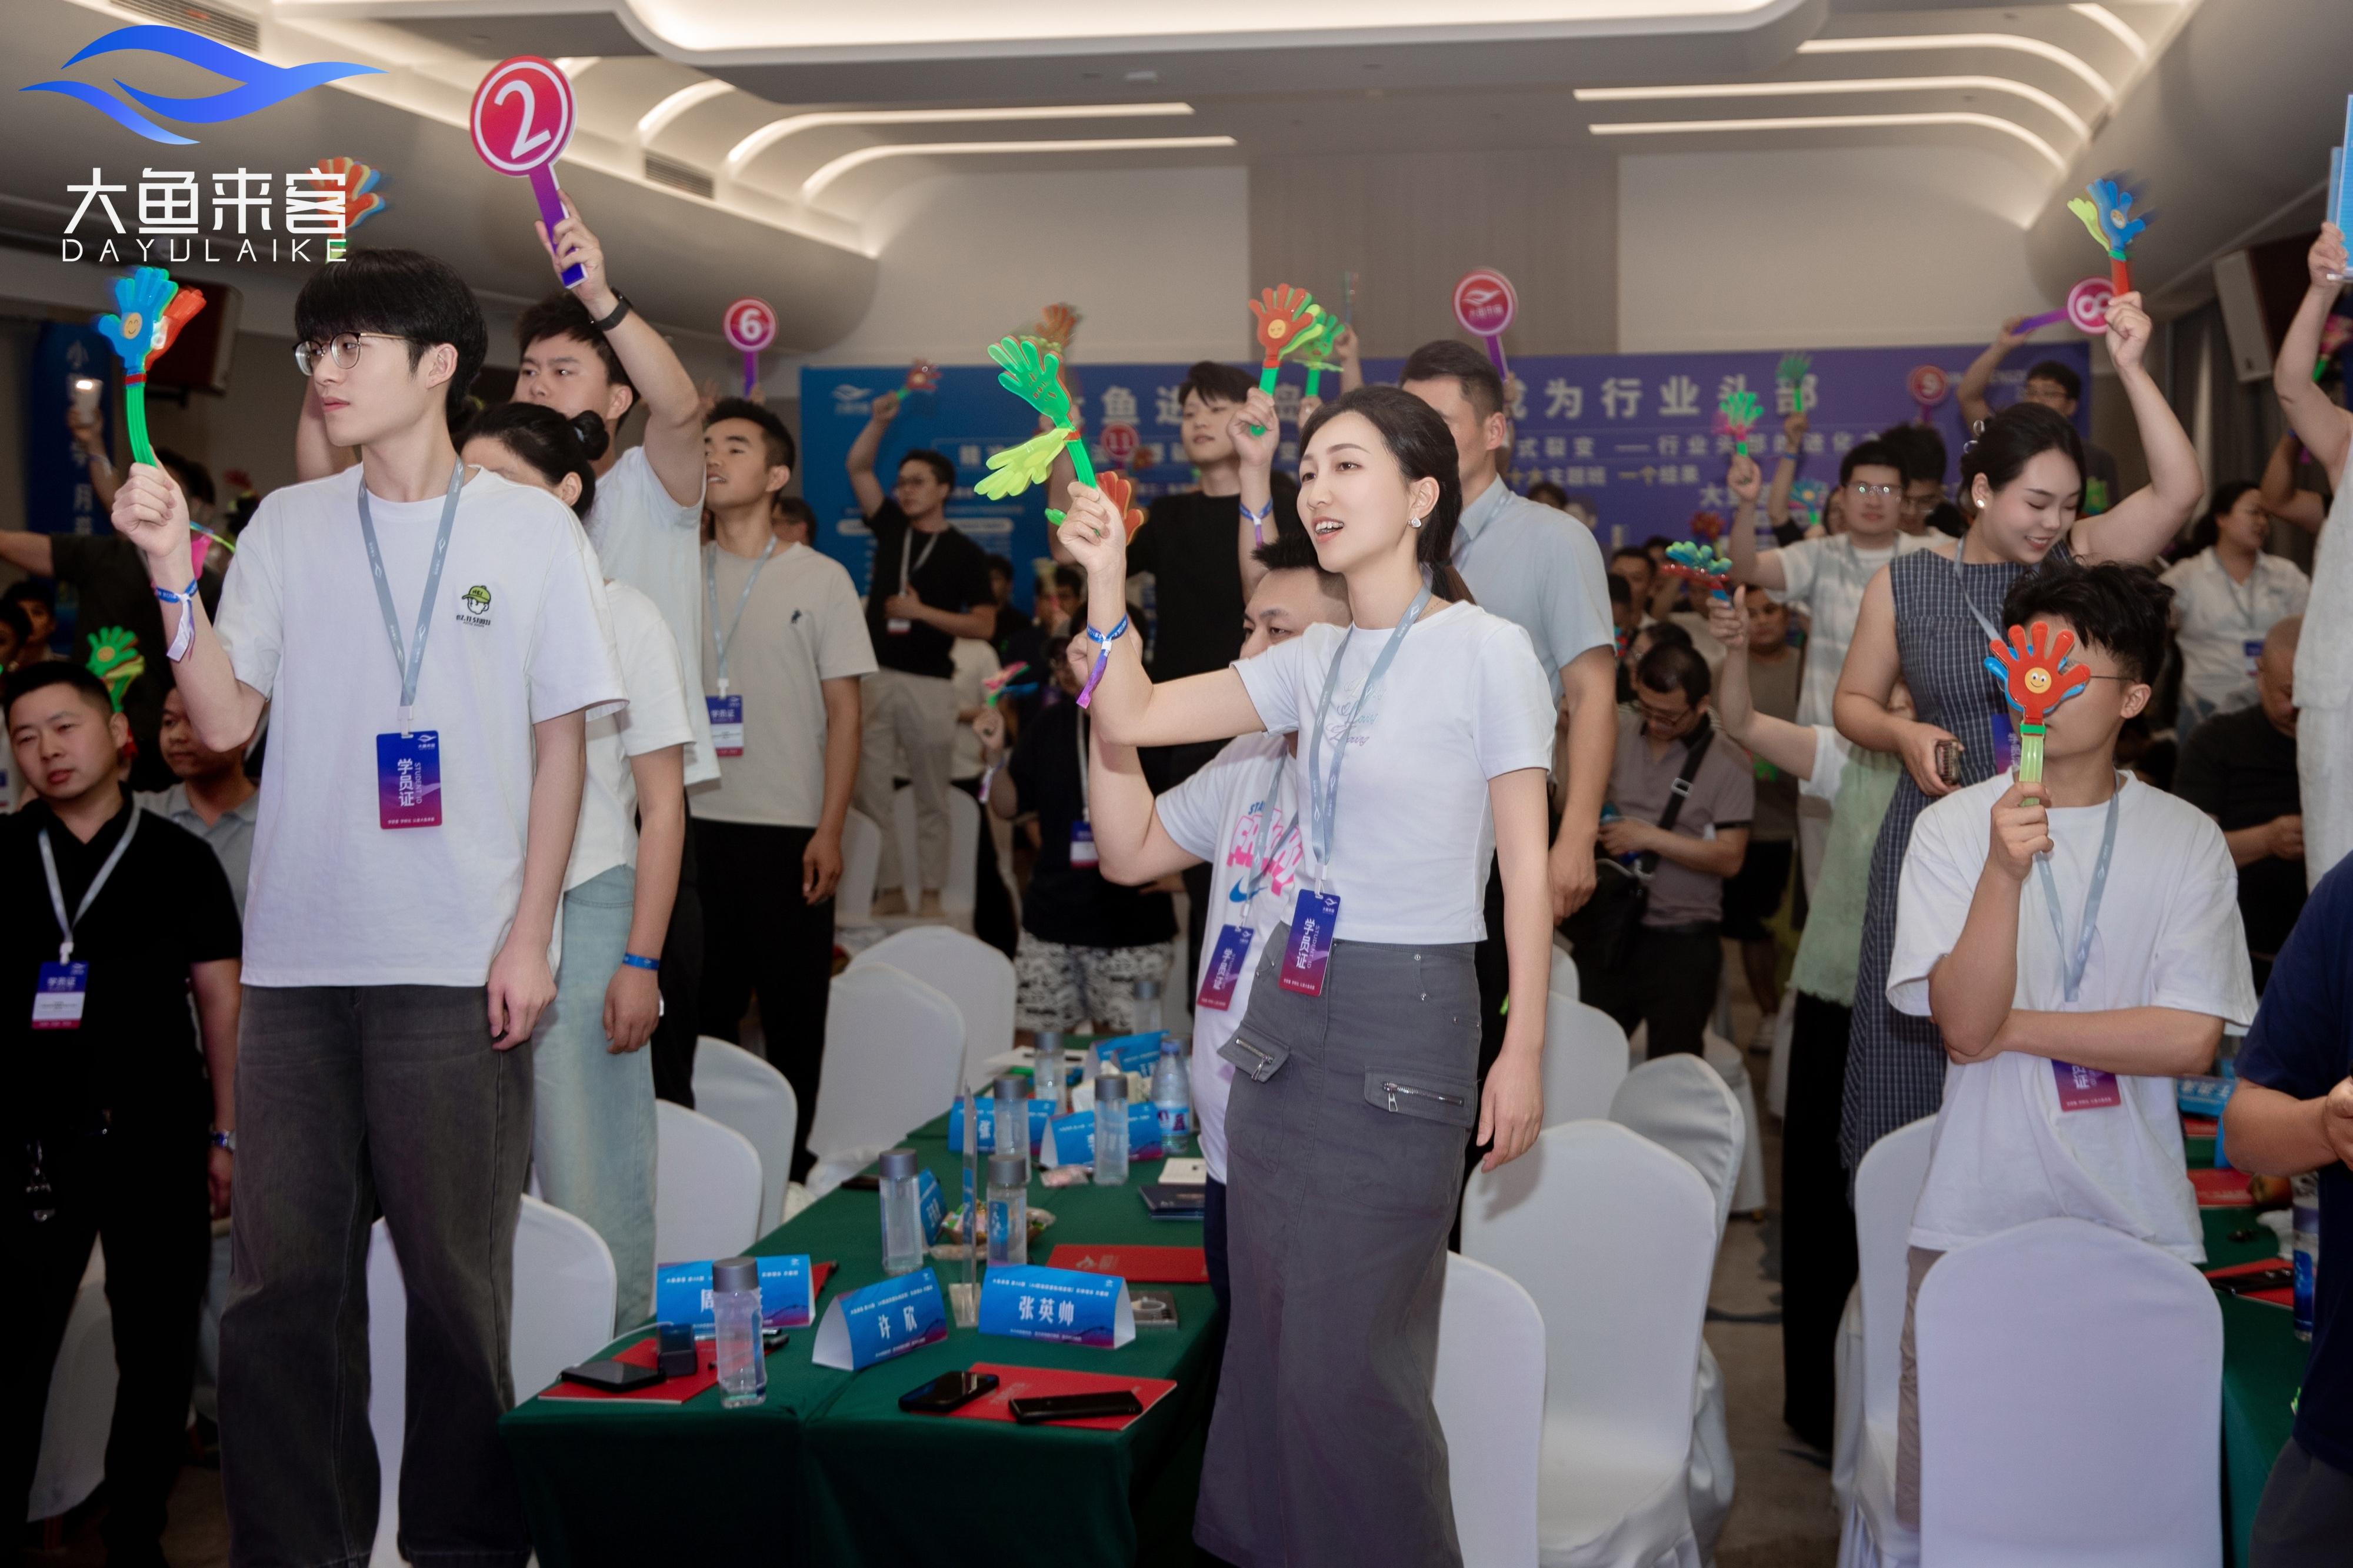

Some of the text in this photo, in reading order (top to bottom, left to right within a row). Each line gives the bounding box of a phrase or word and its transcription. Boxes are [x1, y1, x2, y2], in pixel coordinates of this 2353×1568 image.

[494, 79, 552, 159] 2
[2075, 292, 2114, 320] 8
[739, 308, 762, 341] 6
[397, 758, 415, 807] 学员证
[414, 762, 422, 793] STUDENT
[1296, 917, 1315, 969] 学员证
[1308, 924, 1320, 960] STUDENT
